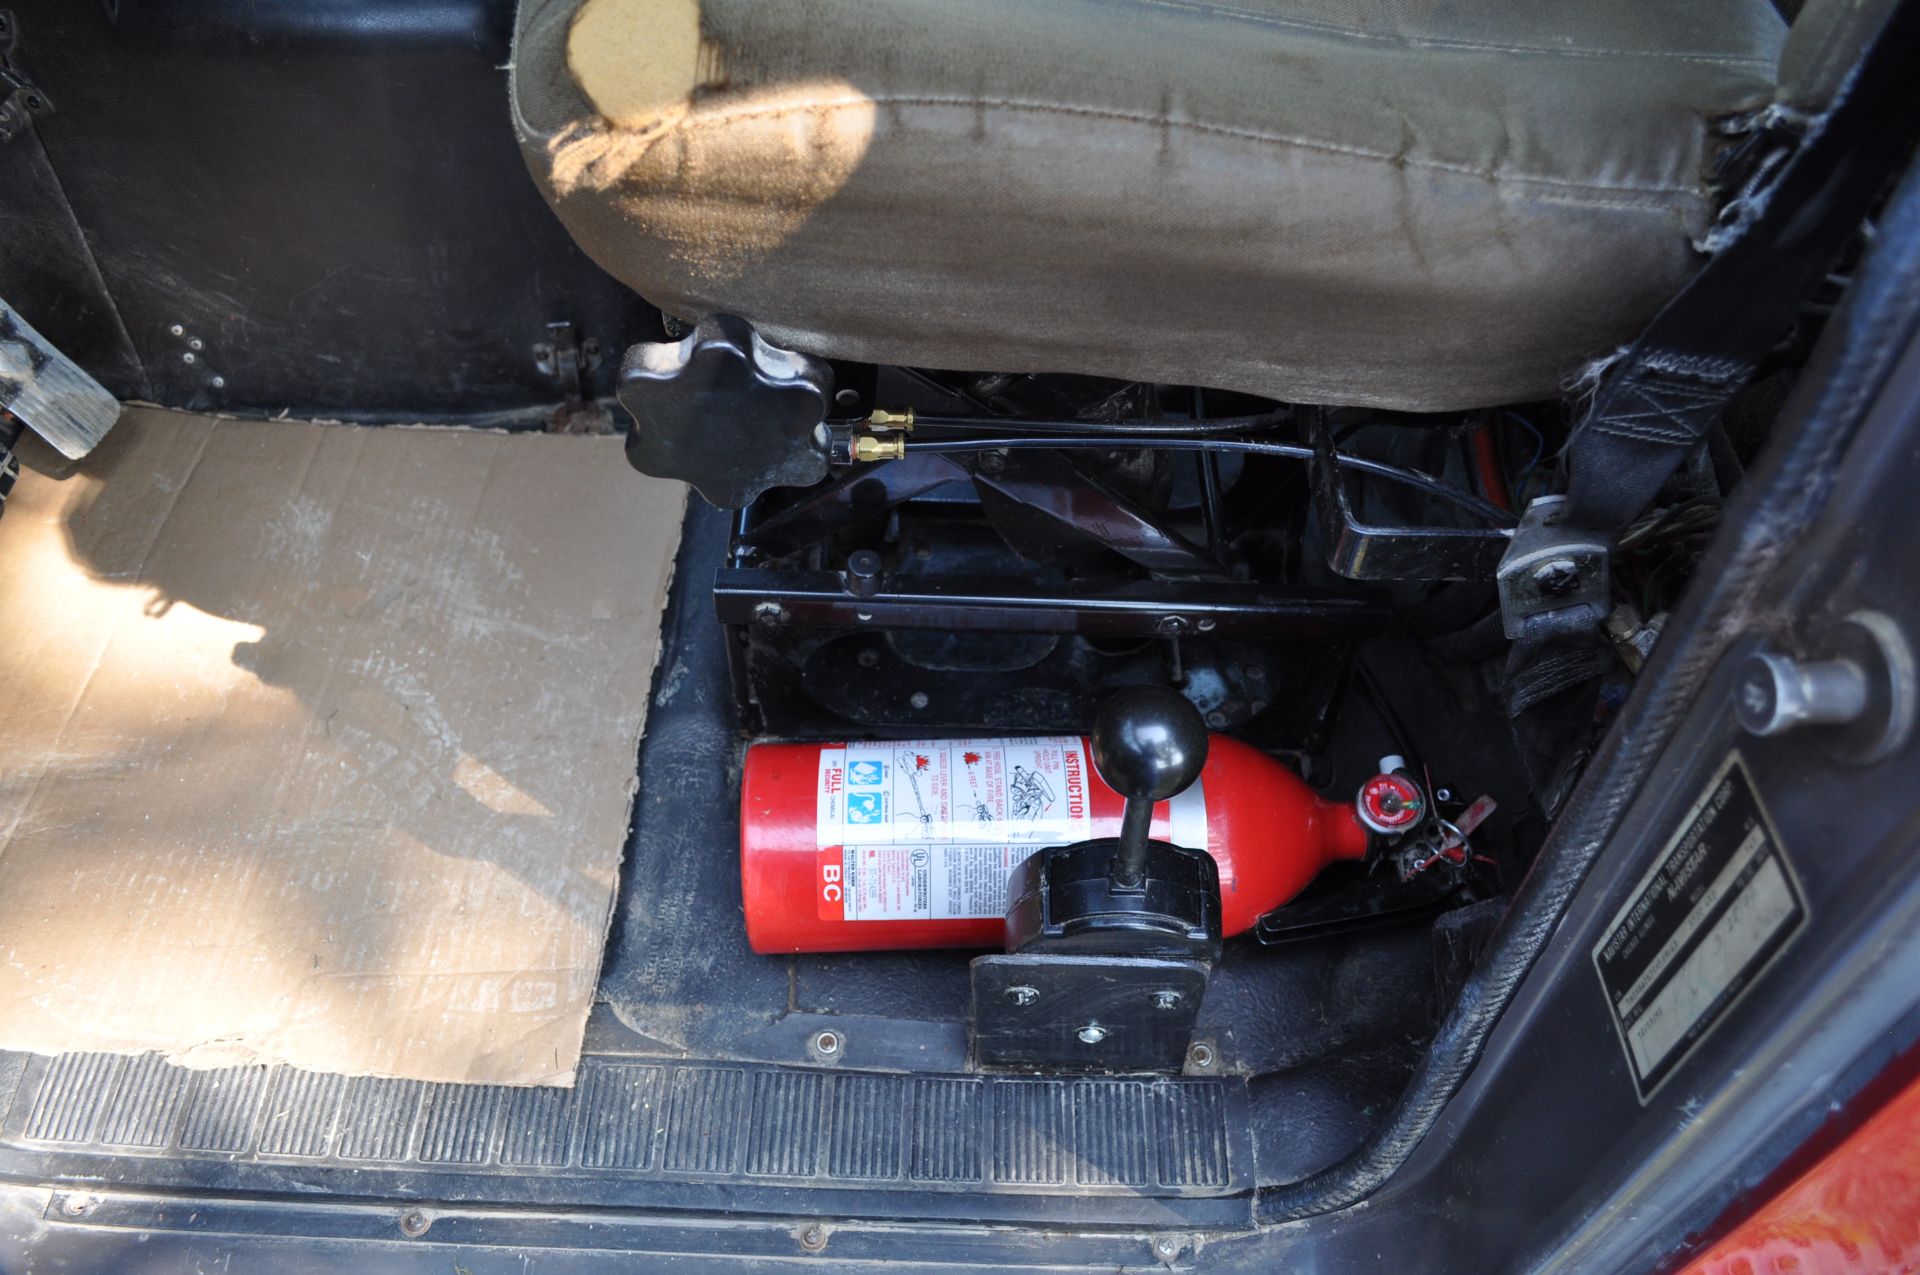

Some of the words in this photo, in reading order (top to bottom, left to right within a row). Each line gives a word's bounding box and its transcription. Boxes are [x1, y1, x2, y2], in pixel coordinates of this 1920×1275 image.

[832, 768, 842, 794] FULL
[940, 771, 948, 787] LEVER
[995, 799, 1003, 816] BACK
[823, 865, 841, 902] BC
[1602, 922, 1629, 966] NAVISTAR
[1625, 868, 1668, 935] INTERNATIONAL
[1665, 800, 1717, 879] TRANSPORTATION
[1665, 838, 1708, 904] NAVISTAR
